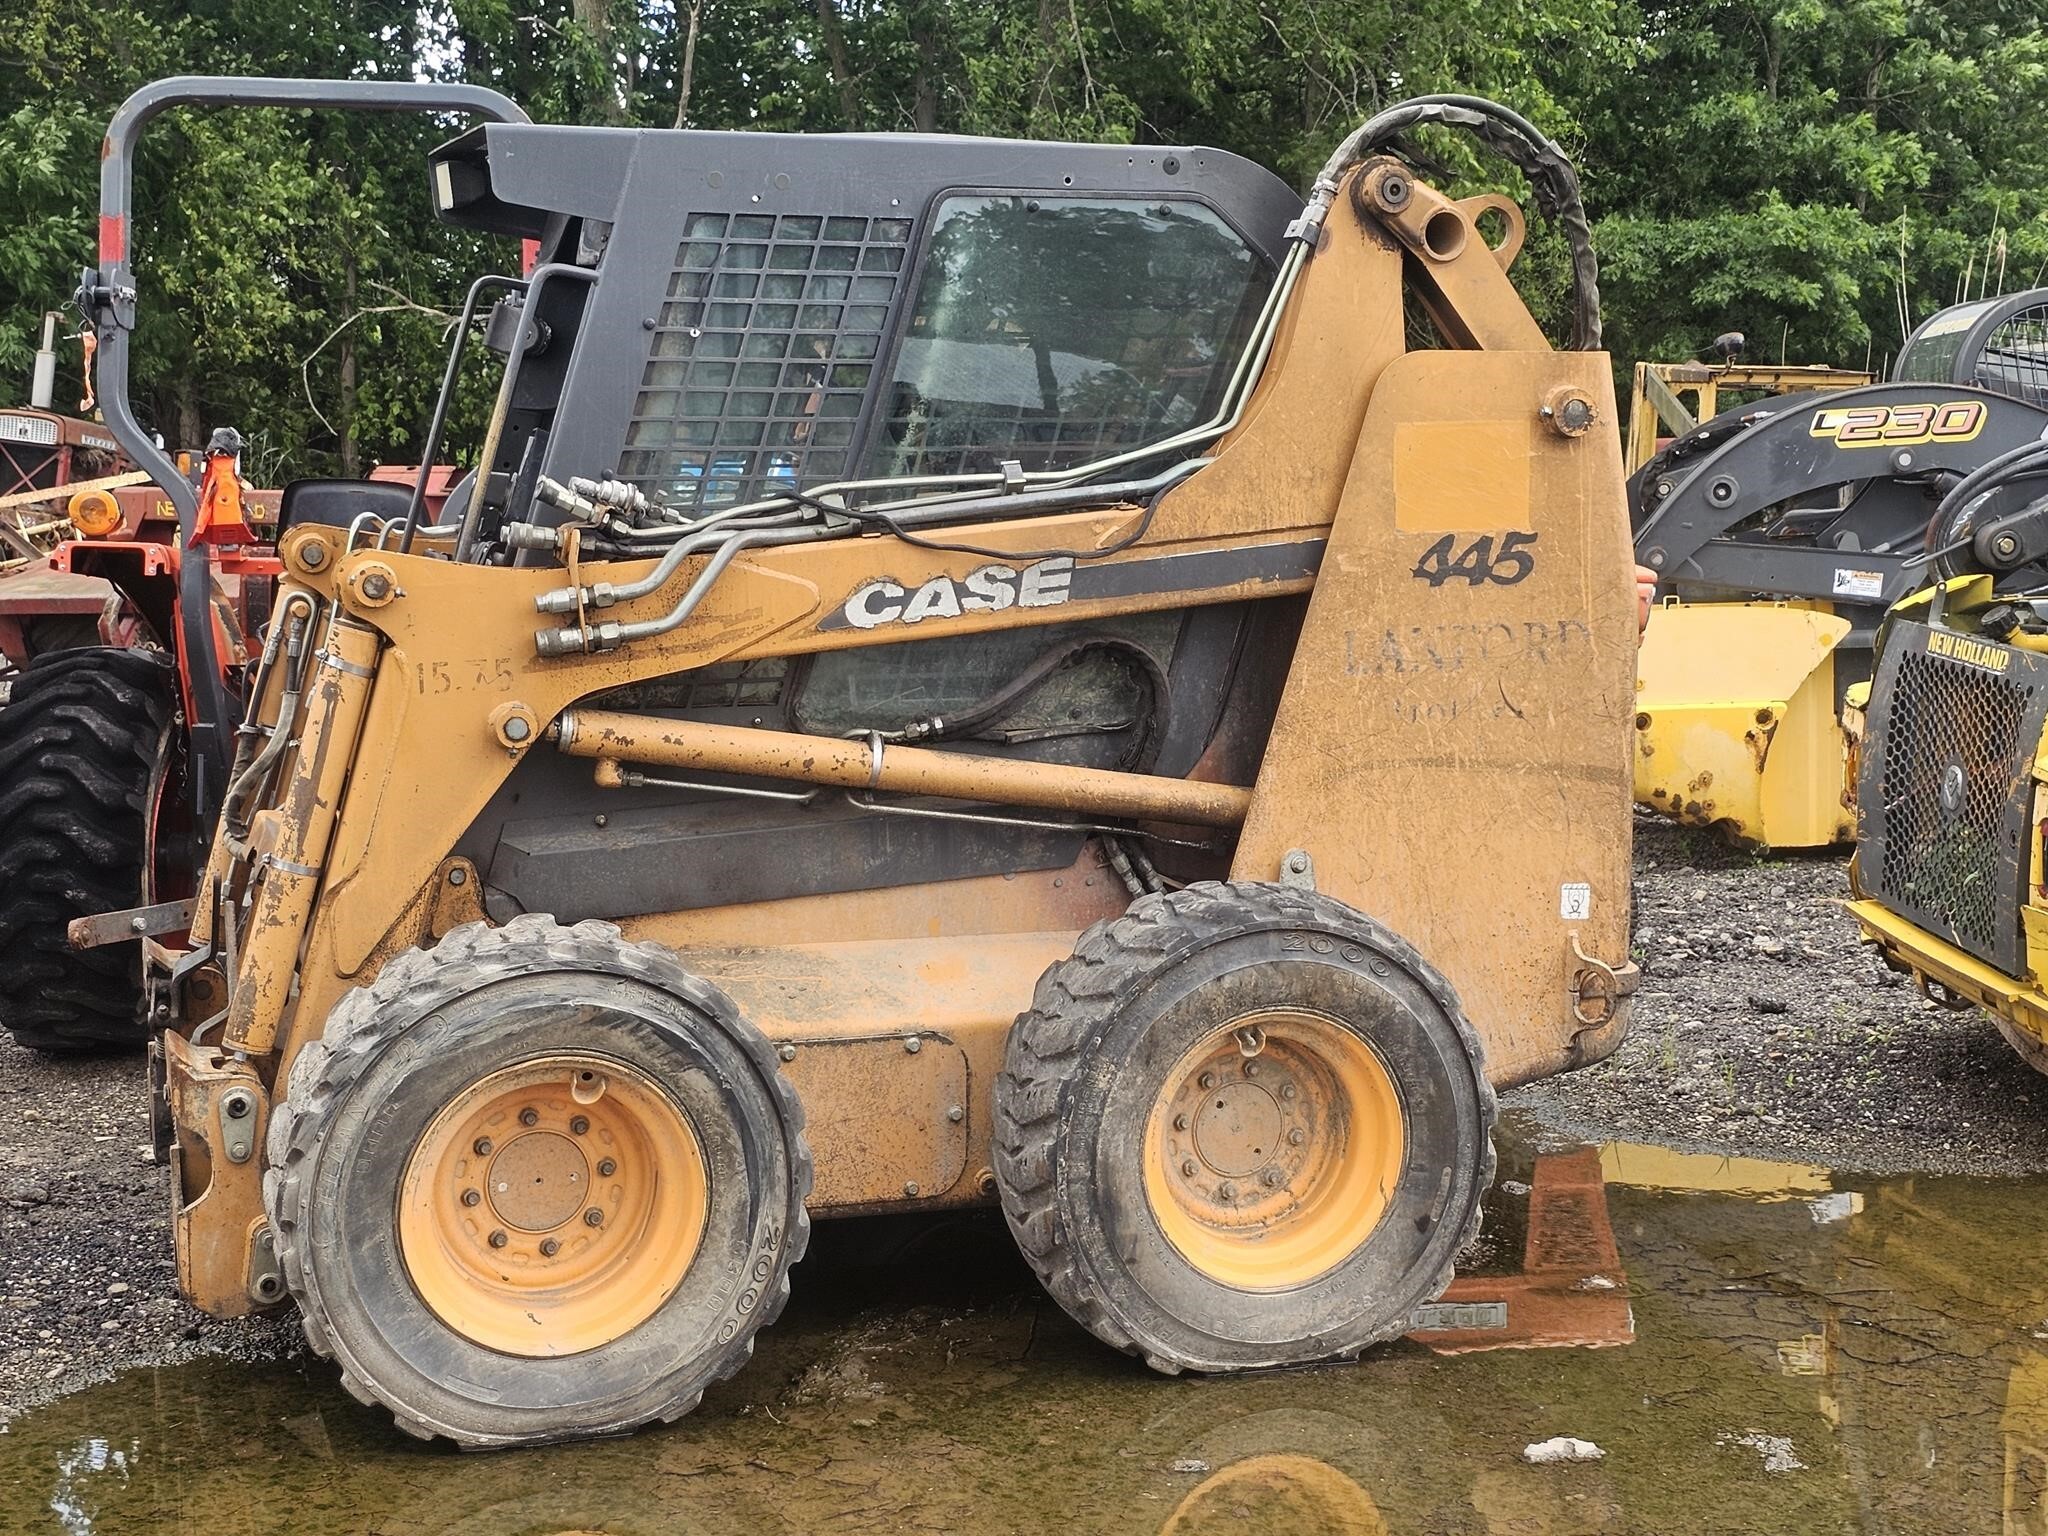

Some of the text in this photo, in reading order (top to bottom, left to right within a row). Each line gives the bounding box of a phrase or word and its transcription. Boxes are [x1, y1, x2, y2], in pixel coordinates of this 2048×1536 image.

[1812, 402, 1984, 445] L230
[1409, 531, 1538, 587] 445
[844, 557, 1075, 629] CASE
[1927, 631, 2010, 671] NEW HOLLAND
[1281, 932, 1392, 977] 2000
[715, 1222, 781, 1345] 2000
